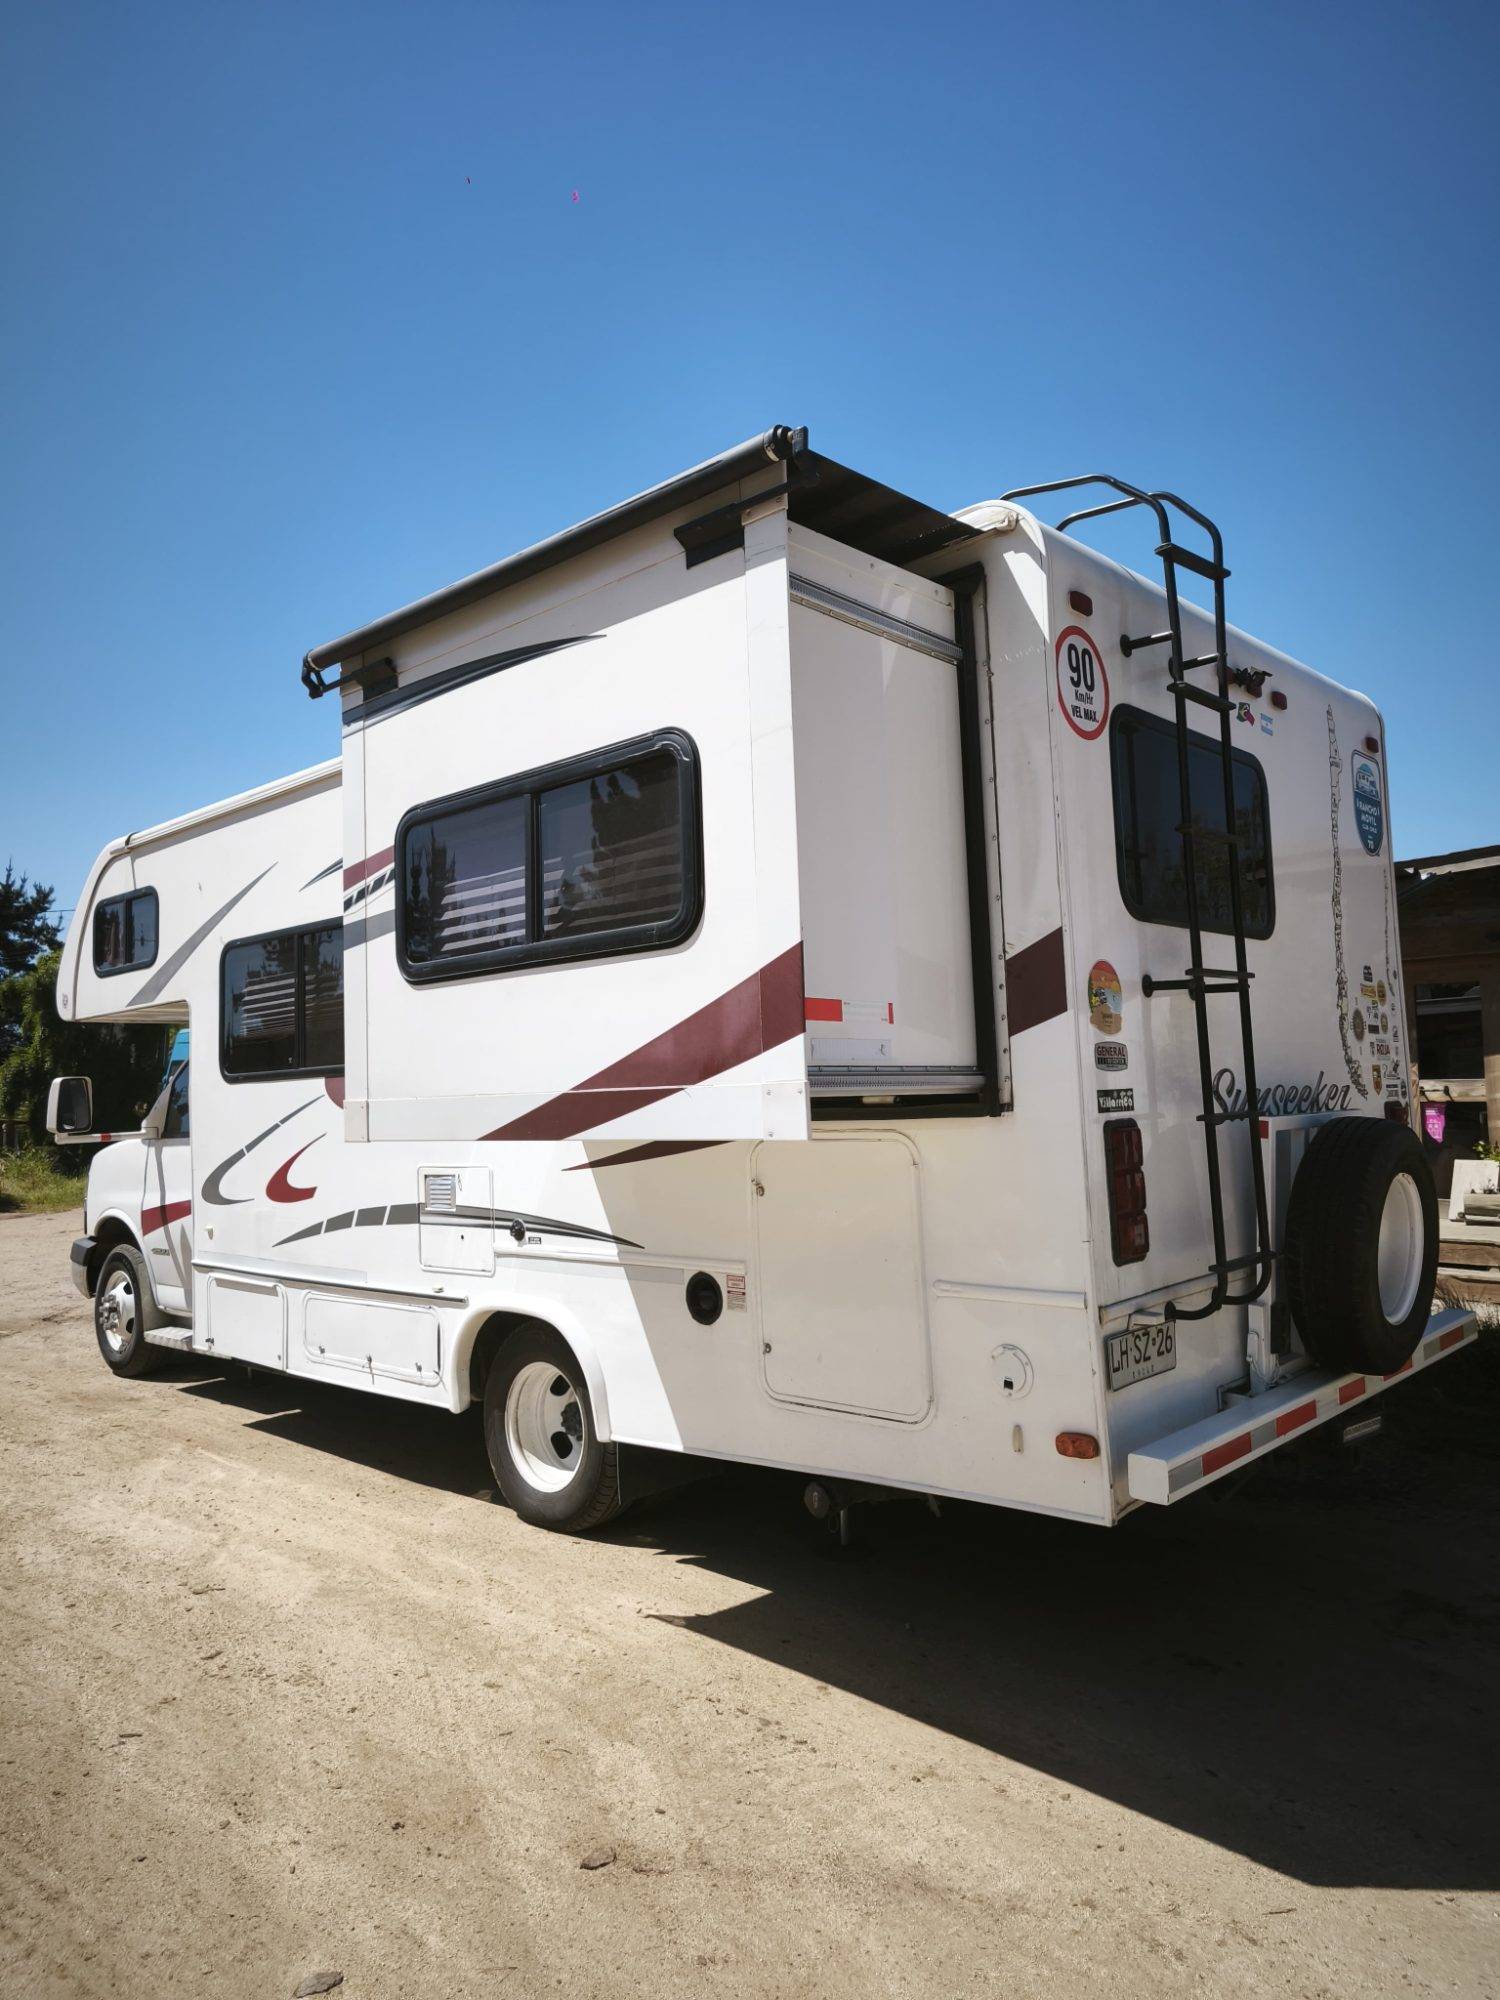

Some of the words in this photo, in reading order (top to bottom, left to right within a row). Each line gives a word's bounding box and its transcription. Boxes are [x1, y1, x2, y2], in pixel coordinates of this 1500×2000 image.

[1067, 643, 1095, 692] 90
[1097, 1046, 1125, 1057] GENERAL
[1213, 1068, 1361, 1123] Sunseeker
